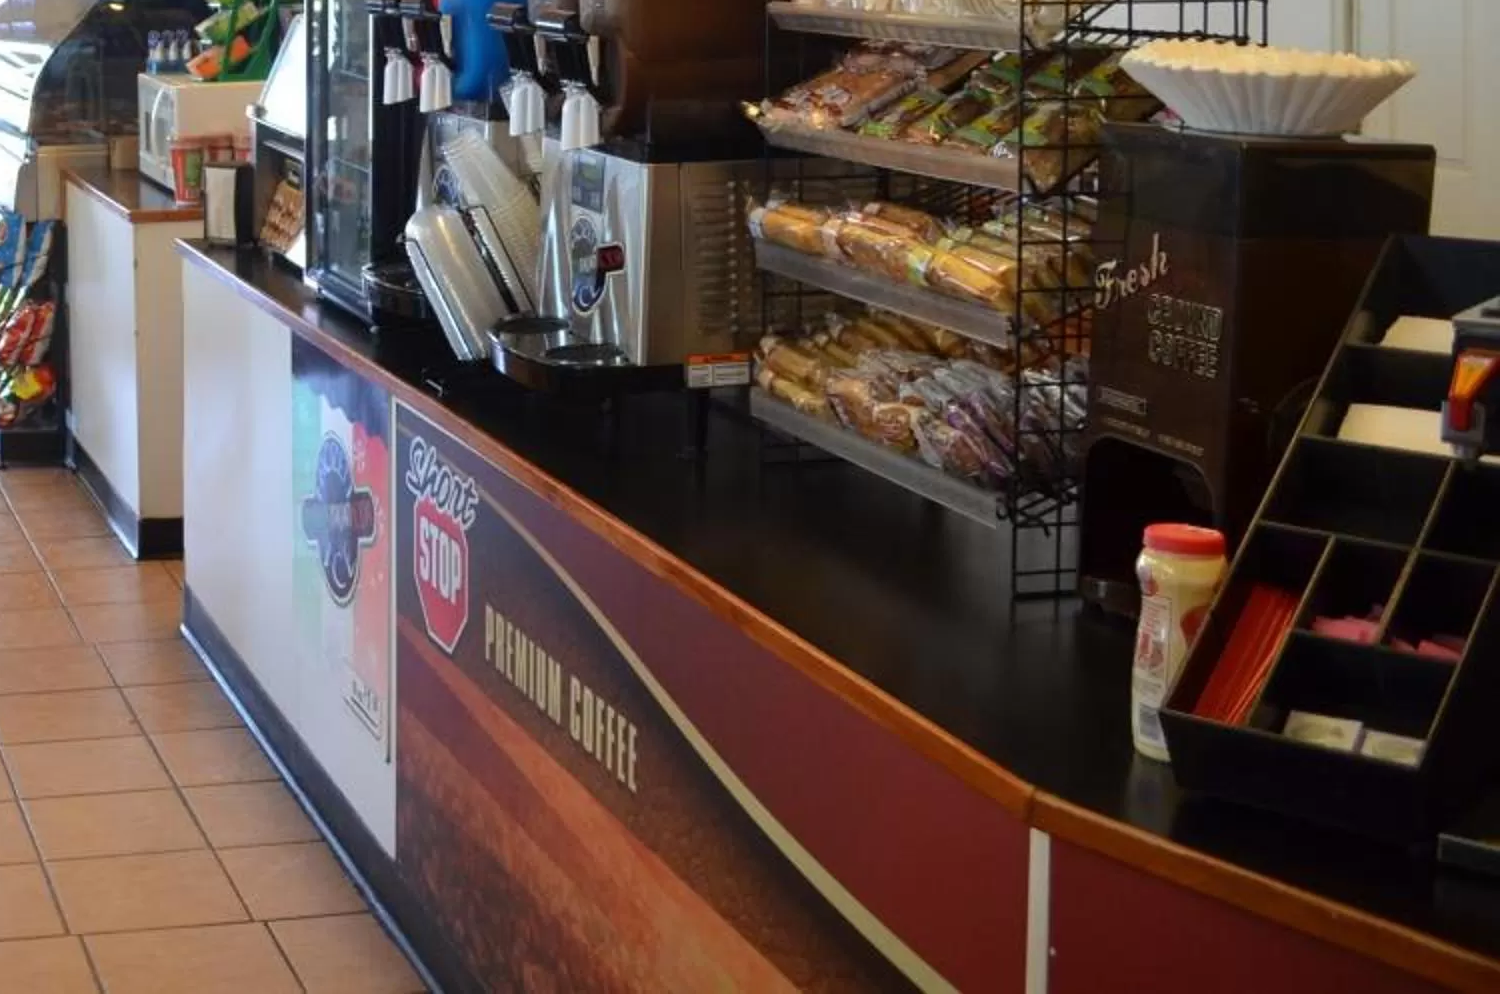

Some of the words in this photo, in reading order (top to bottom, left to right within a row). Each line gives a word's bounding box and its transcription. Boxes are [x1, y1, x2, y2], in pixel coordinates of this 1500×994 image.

[1095, 232, 1168, 308] Fresh
[406, 437, 478, 531] Short
[419, 517, 462, 604] STOP
[484, 603, 563, 725] PREMIUM
[569, 675, 637, 794] COFFEE
